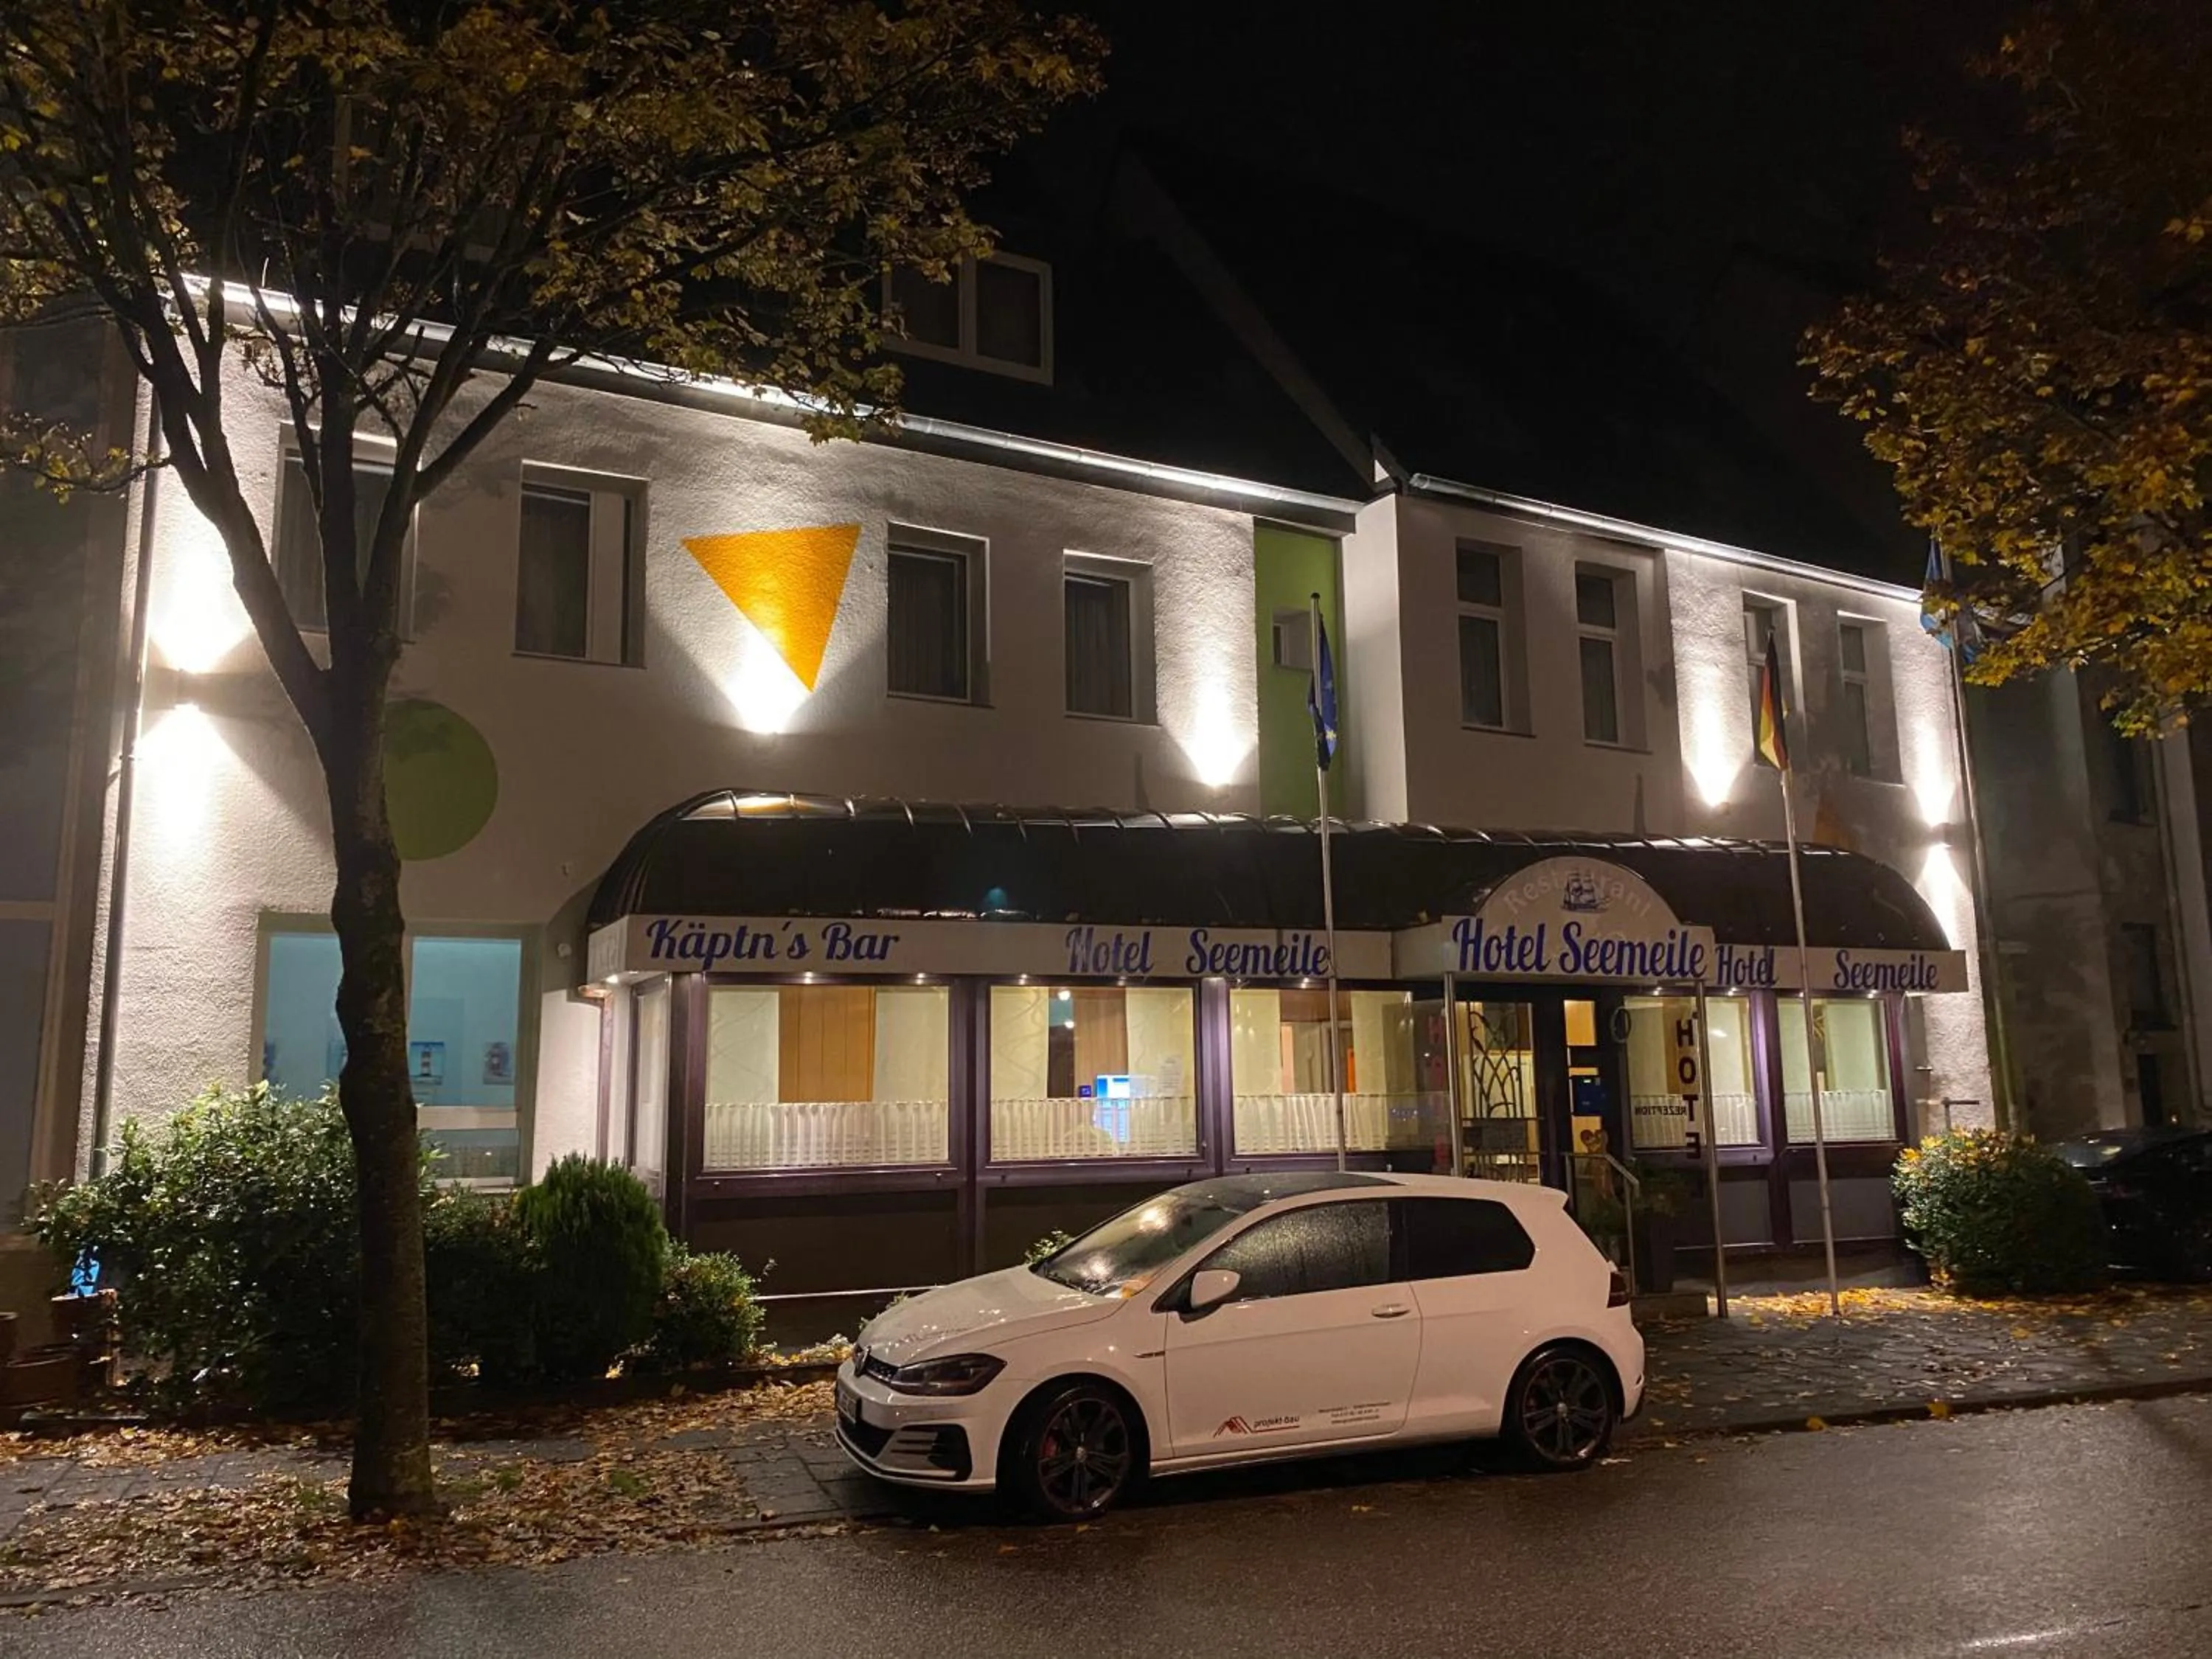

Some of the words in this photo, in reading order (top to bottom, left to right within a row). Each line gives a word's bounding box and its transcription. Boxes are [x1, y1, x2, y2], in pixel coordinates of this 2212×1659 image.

[821, 922, 900, 961] Bar
[1065, 926, 1155, 974] Hotel
[1186, 928, 1329, 975] Seemeile
[1453, 918, 1551, 972] Hotel
[1559, 921, 1707, 978] Seemeile
[1715, 945, 1779, 987] Hotel
[1834, 949, 1941, 990] Seemeile
